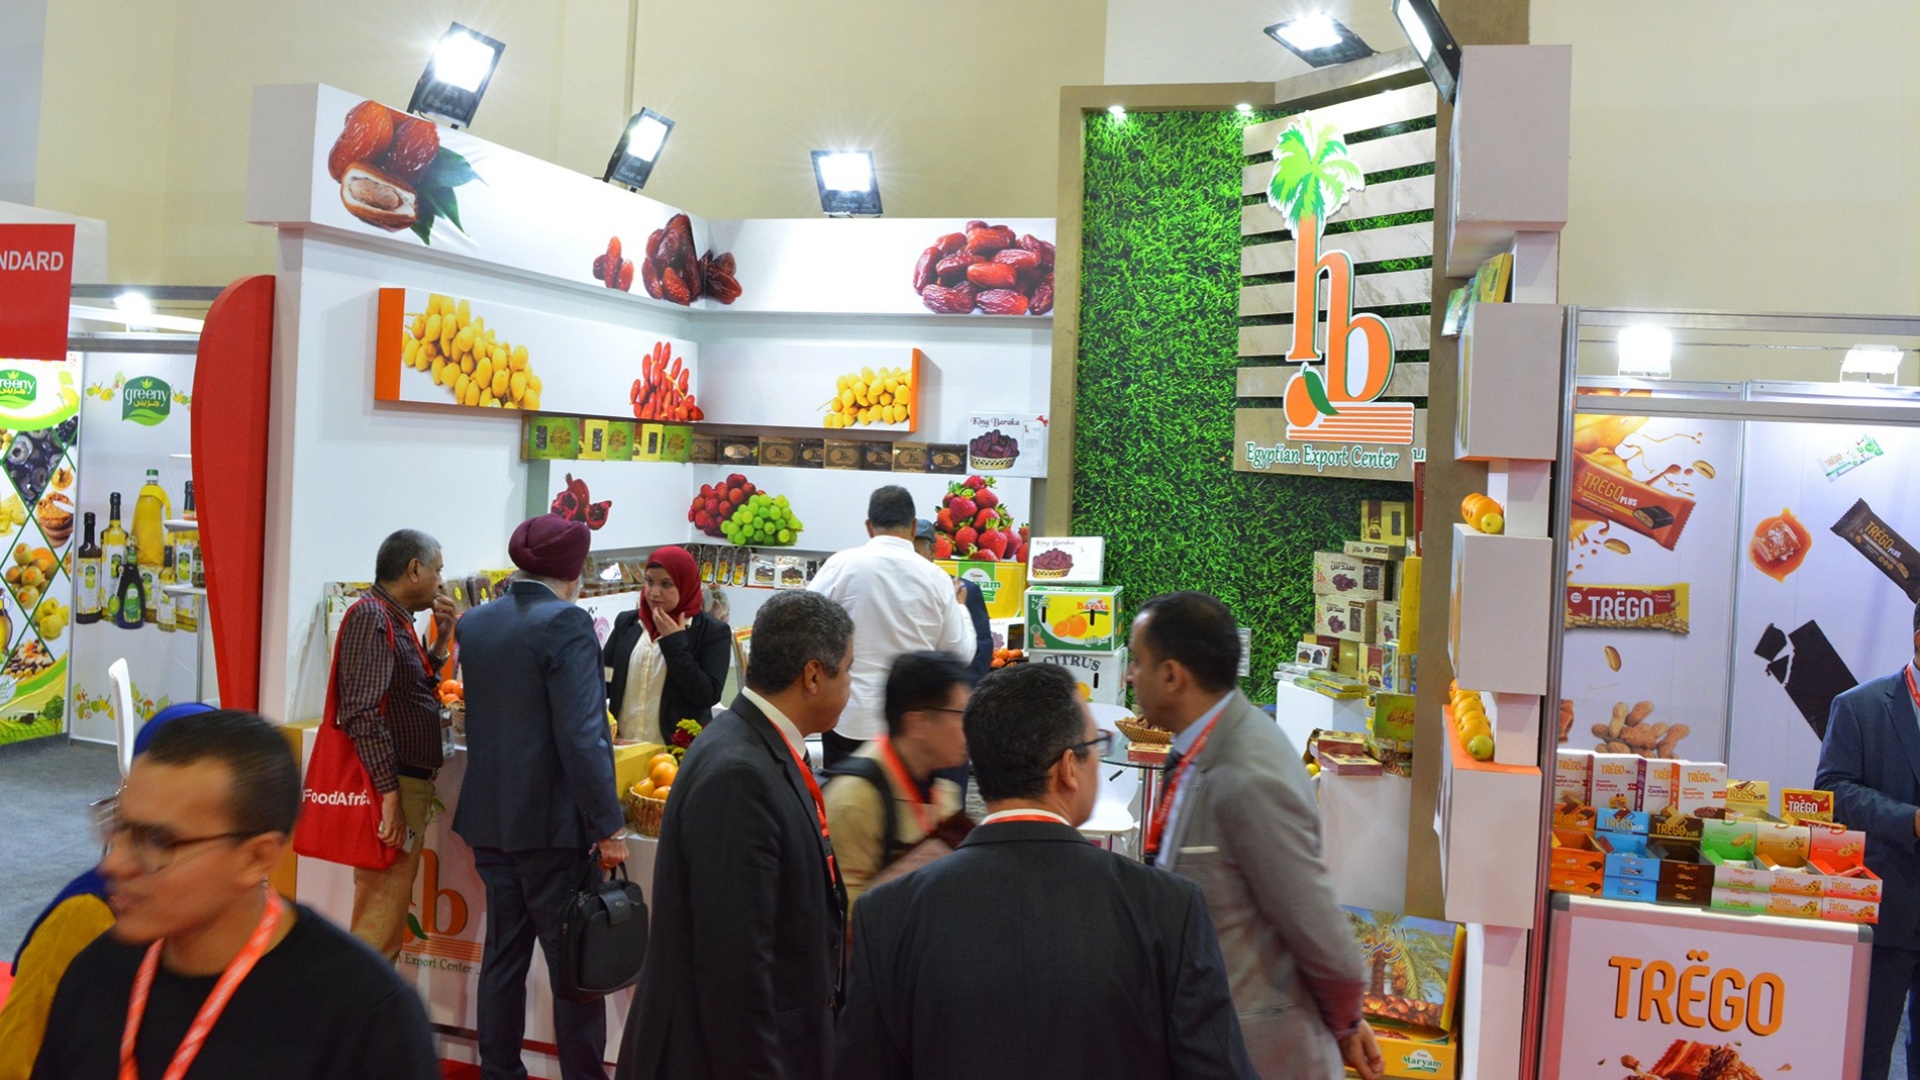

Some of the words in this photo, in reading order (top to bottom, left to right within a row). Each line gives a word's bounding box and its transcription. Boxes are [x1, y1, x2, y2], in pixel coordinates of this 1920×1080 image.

[125, 388, 169, 407] greeny
[970, 416, 989, 428] King
[991, 416, 1020, 427] Baraka
[1246, 443, 1300, 468] Egyptian
[1303, 445, 1348, 472] Export
[1351, 446, 1399, 469] Center
[1619, 495, 1638, 507] PLUS
[1043, 655, 1101, 672] CITRUS
[405, 953, 437, 968] Export
[440, 958, 472, 973] Center
[1608, 949, 1786, 1037] TRËGO
[1403, 1056, 1442, 1067] Maryam
